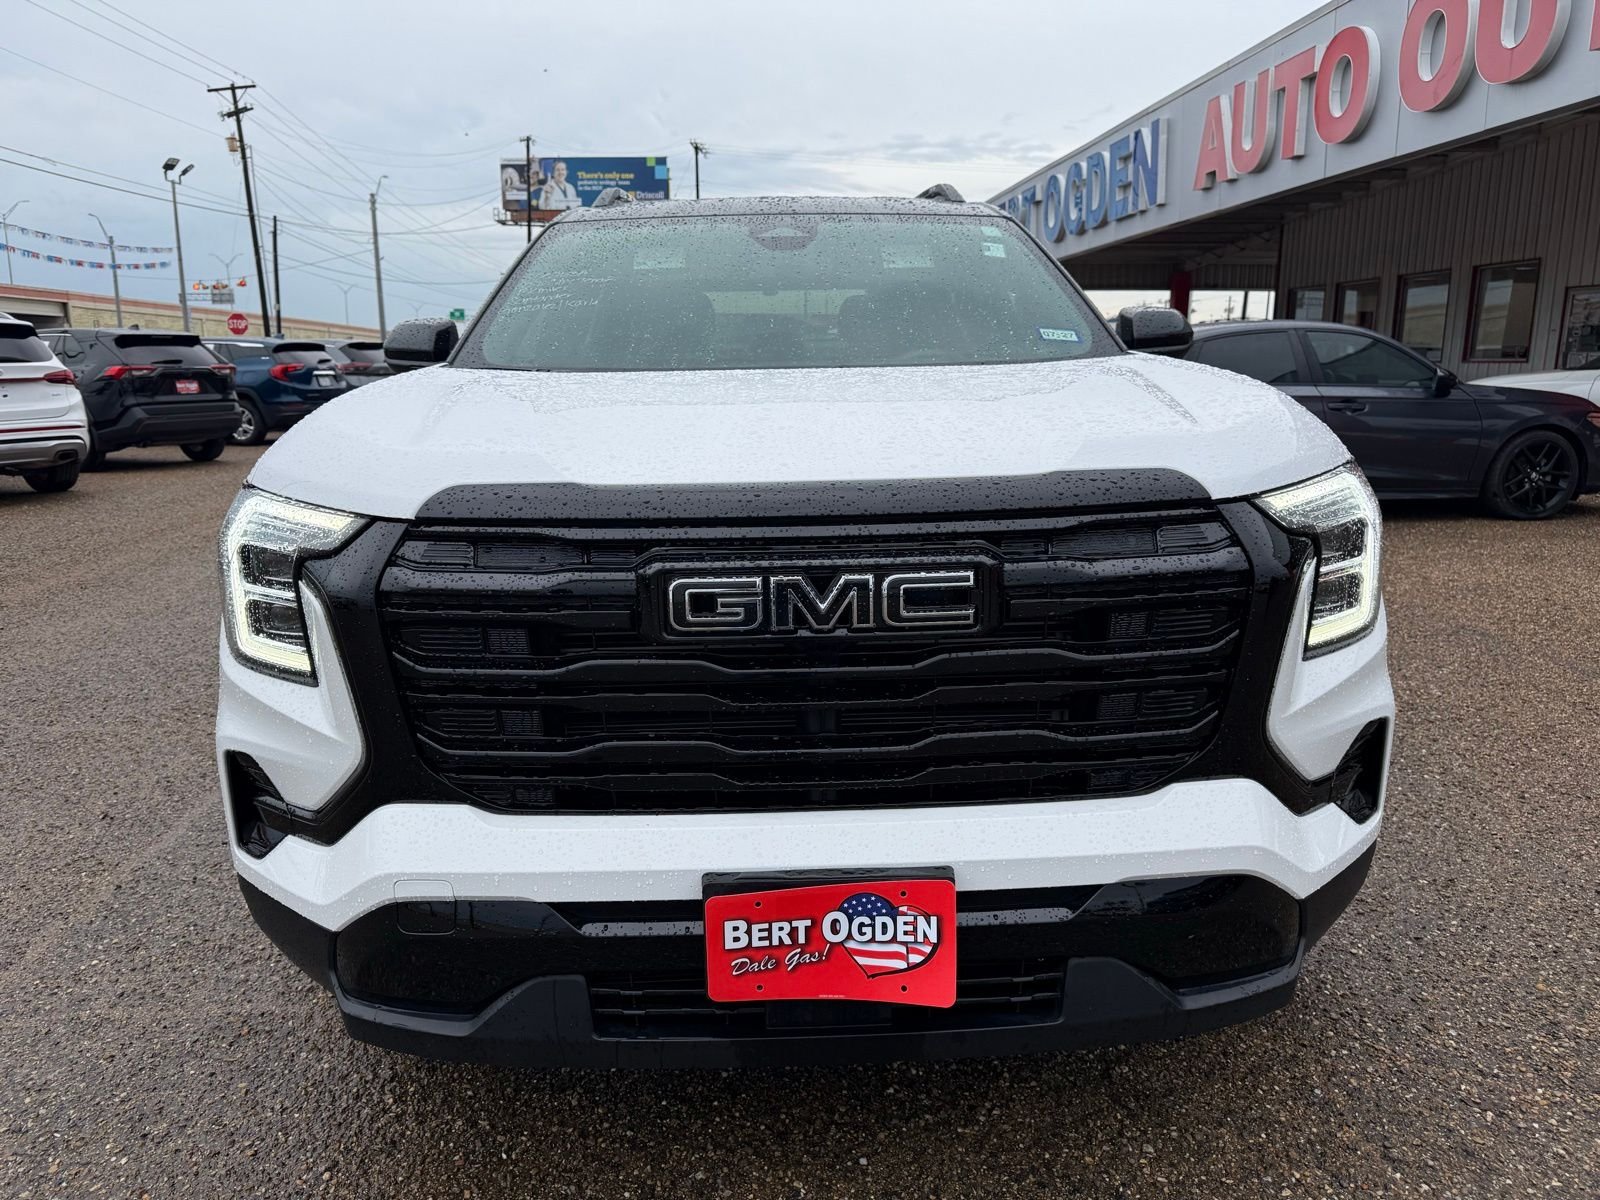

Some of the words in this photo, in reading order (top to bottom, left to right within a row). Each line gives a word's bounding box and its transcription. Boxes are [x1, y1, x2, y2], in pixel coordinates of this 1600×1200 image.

[1043, 118, 1167, 243] OGDEN
[1193, 26, 1380, 190] AUTO
[1398, 0, 1600, 112] OU
[577, 171, 603, 179] There's
[604, 171, 620, 180] only
[636, 191, 665, 199] Driscoll
[228, 320, 248, 329] STOP
[668, 571, 975, 632] GMC
[724, 919, 811, 950] BERT
[821, 910, 938, 944] OGDEN
[731, 956, 776, 976] Dale
[784, 943, 830, 972] Gas!
